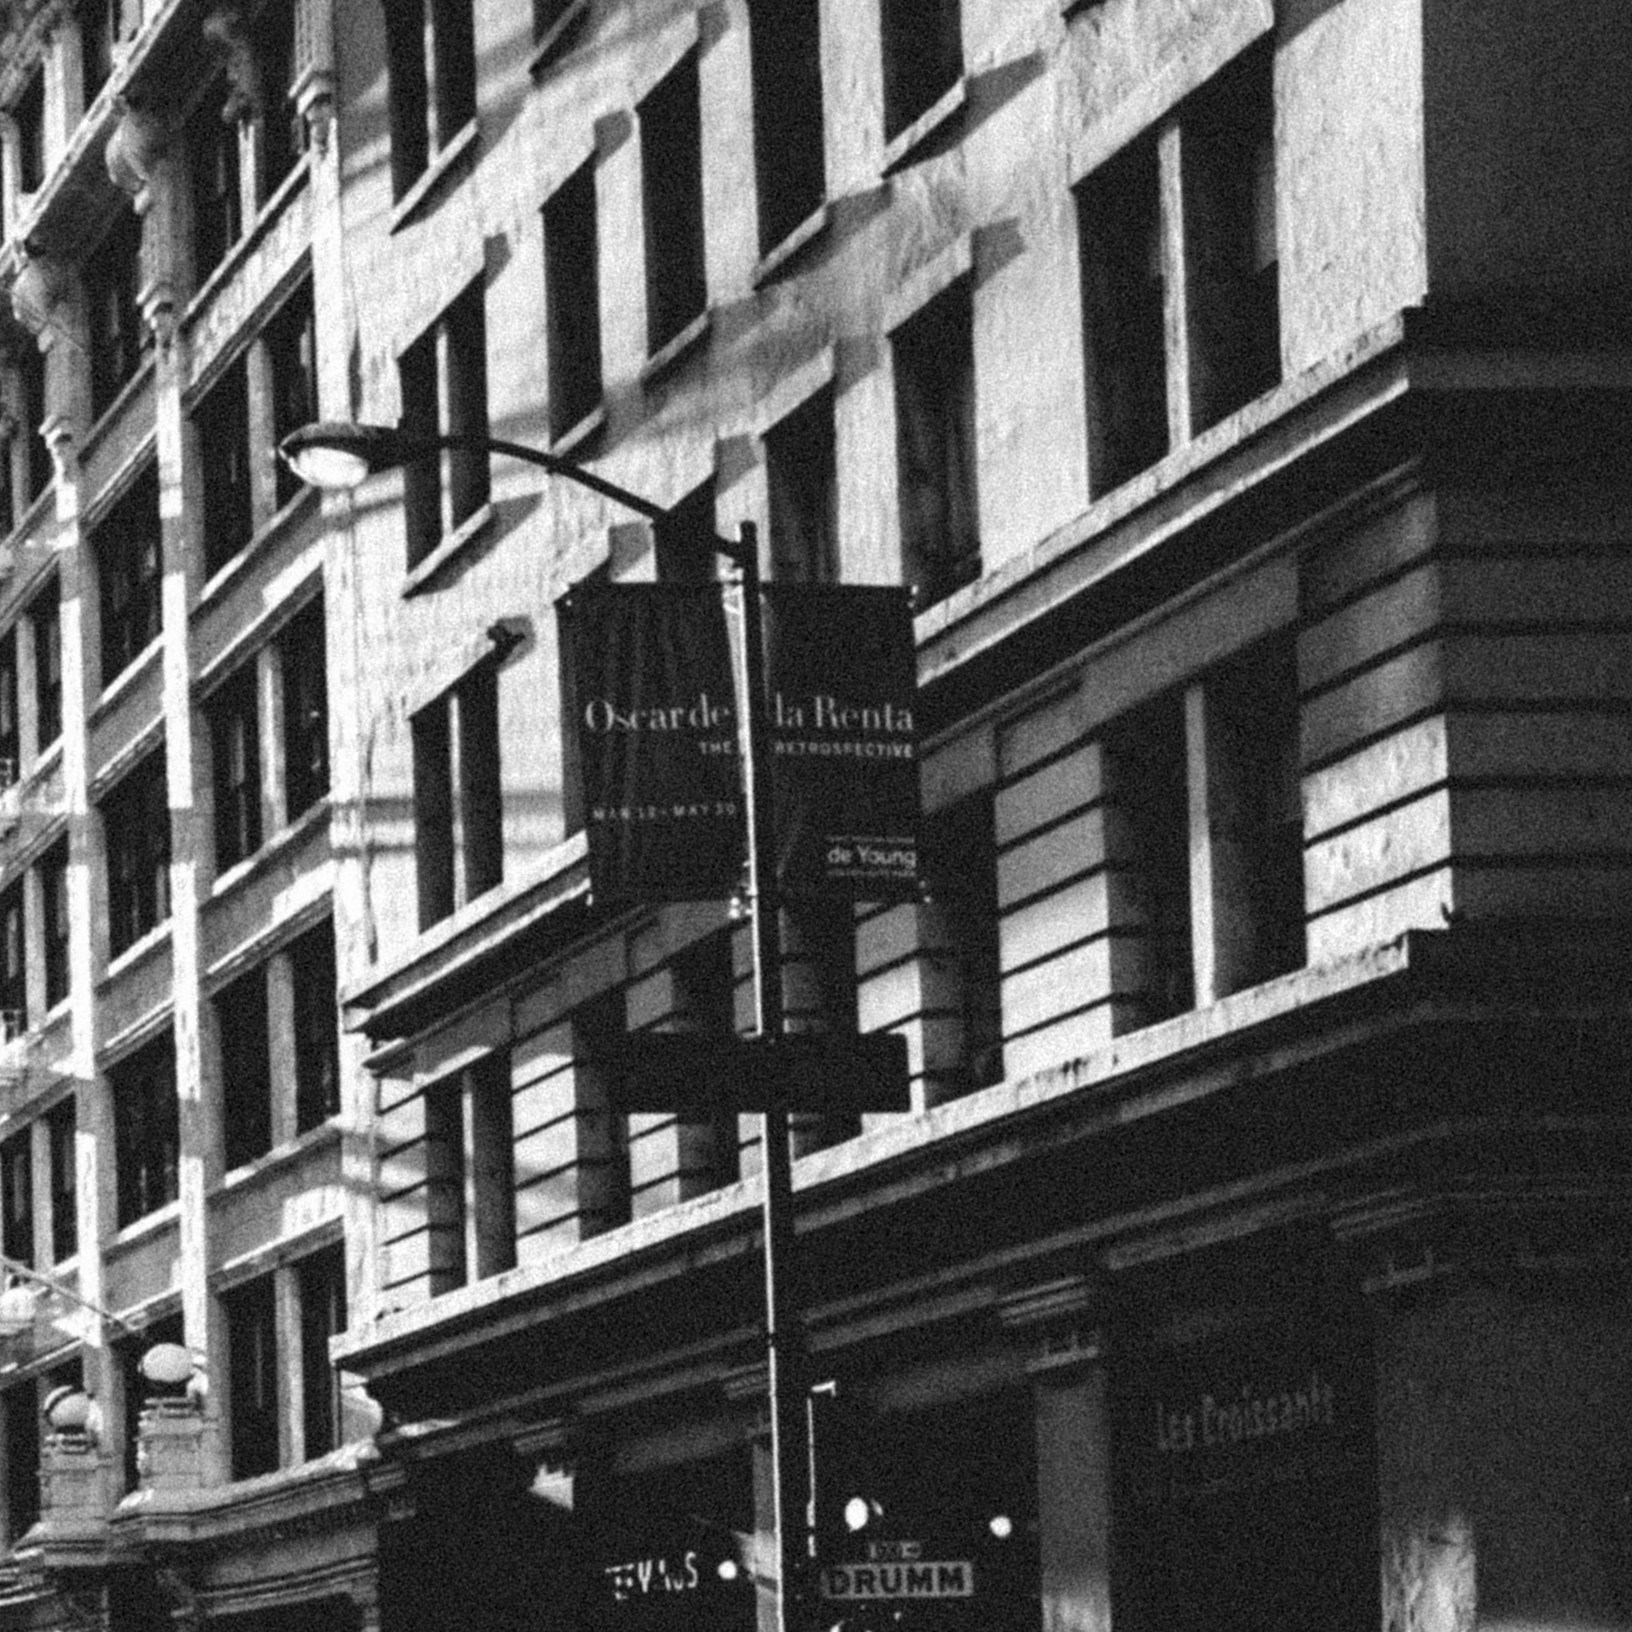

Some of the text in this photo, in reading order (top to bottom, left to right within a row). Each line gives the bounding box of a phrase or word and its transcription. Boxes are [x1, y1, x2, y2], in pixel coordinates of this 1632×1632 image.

[584, 692, 731, 731] Oscar de
[774, 692, 914, 732] la Renta
[698, 741, 733, 755] THE
[774, 740, 914, 758] RETROSPECTIVE
[827, 845, 917, 869] de Young
[829, 1566, 964, 1595] DRUMM
